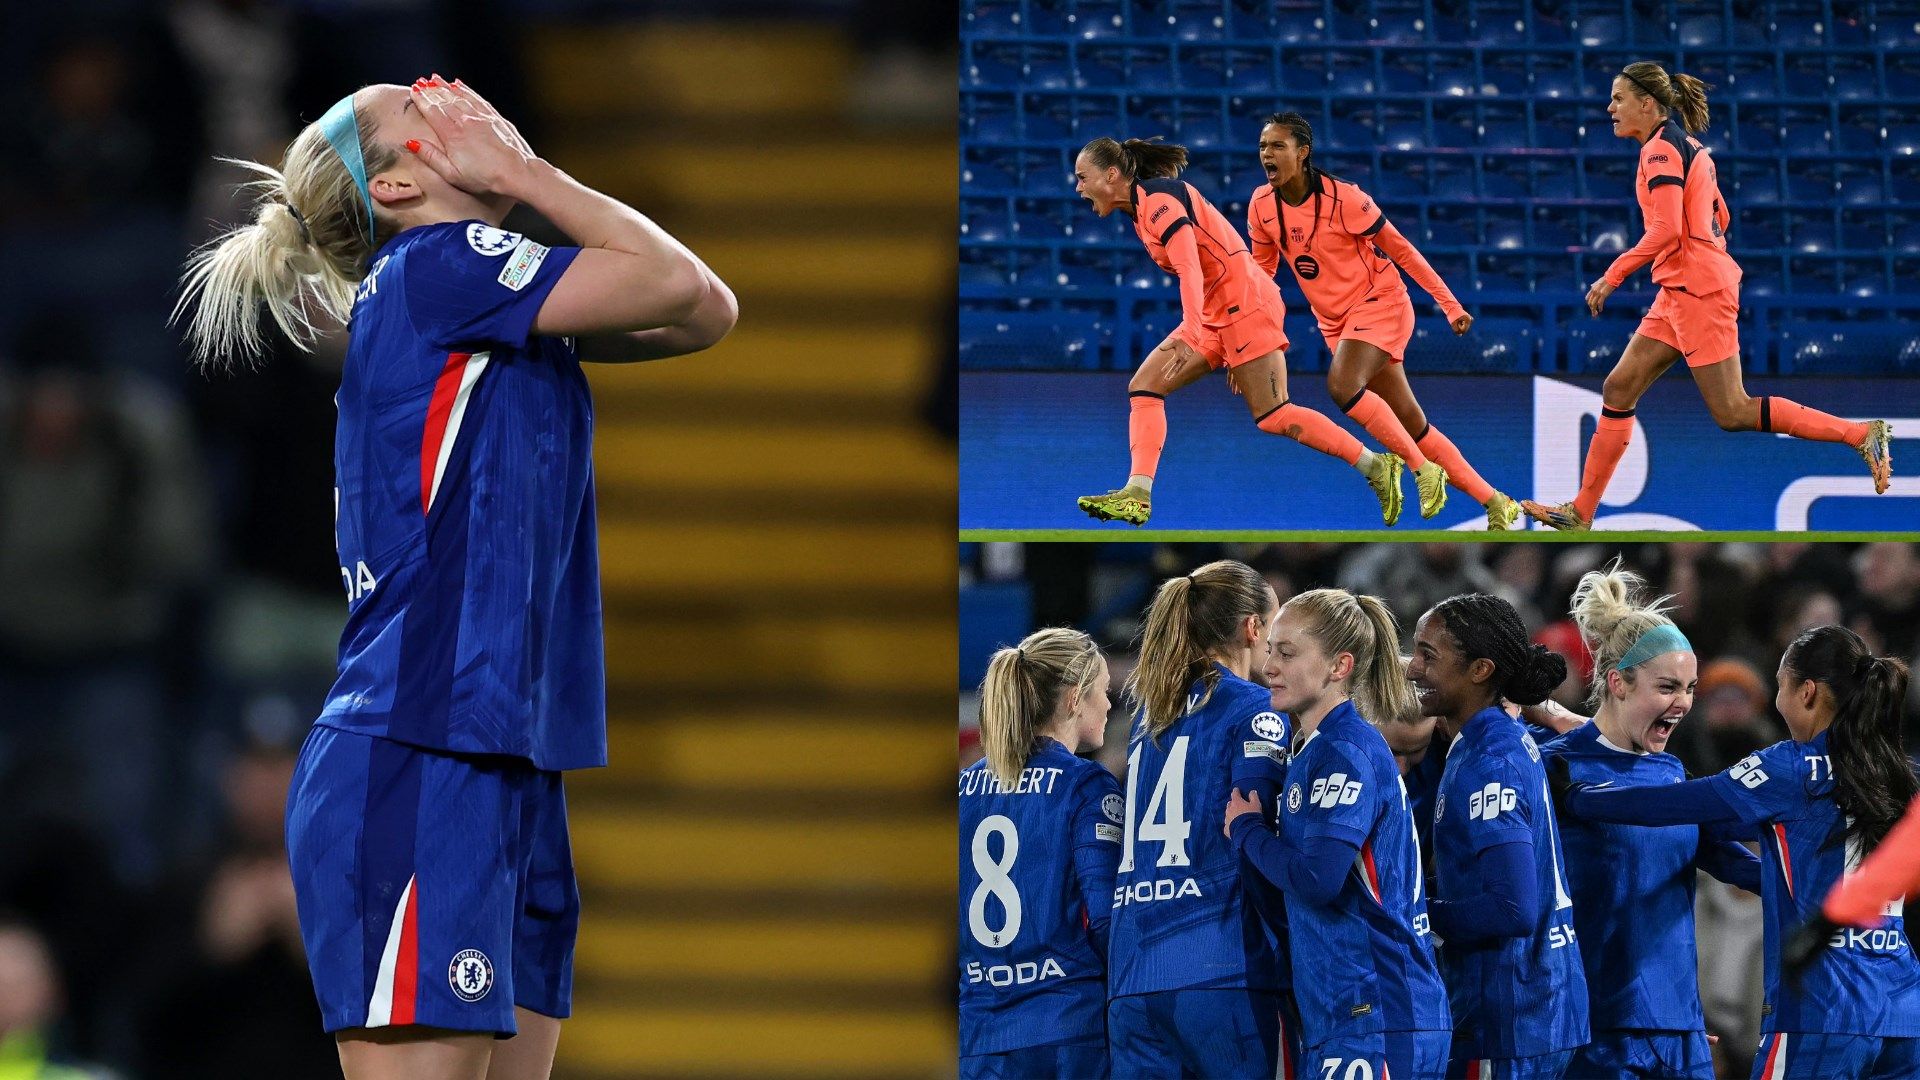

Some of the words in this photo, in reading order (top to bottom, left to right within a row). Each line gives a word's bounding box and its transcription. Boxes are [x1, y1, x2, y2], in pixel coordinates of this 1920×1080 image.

[1117, 735, 1191, 873] 14
[1470, 793, 1515, 814] FPT
[968, 814, 1022, 948] 8
[966, 958, 1067, 987] SODA
